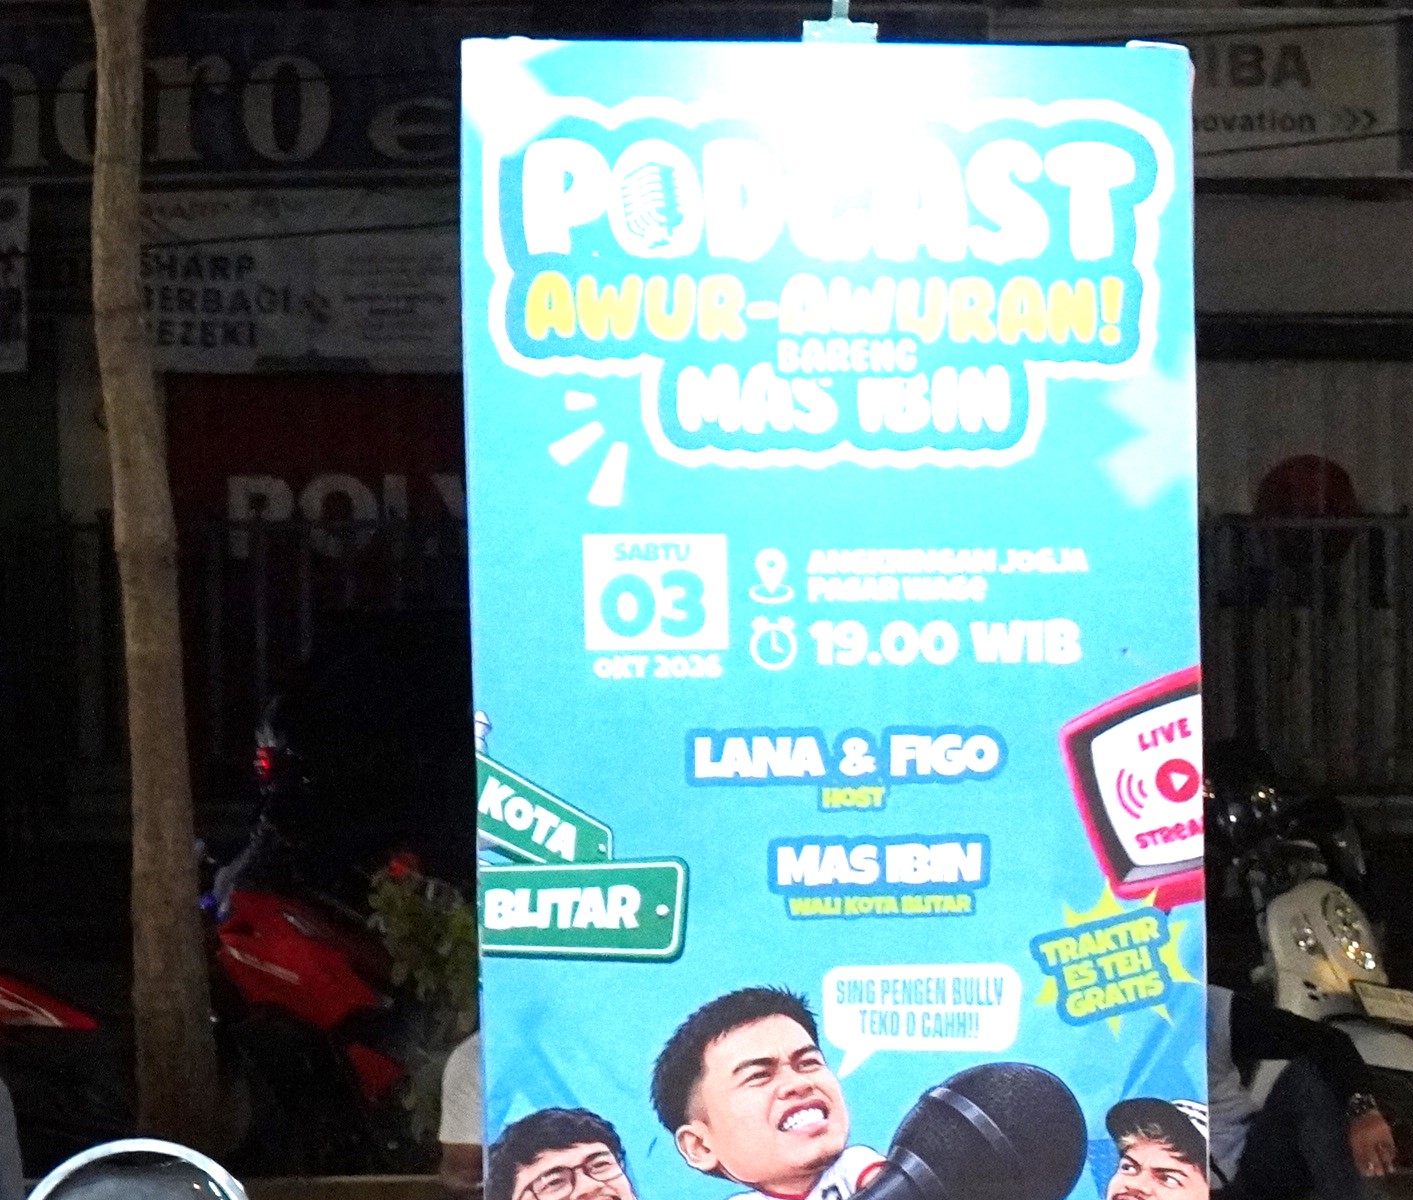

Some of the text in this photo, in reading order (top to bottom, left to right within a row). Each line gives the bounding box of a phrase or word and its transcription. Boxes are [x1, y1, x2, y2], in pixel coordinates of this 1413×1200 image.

[1193, 109, 1316, 133] ovation
[521, 137, 1137, 263] PODCAST
[524, 270, 1125, 346] AWUR-AWURAN!
[143, 319, 258, 347] EZEKI
[777, 337, 919, 373] BARENG
[675, 364, 1012, 434] MAS IBIN
[614, 542, 691, 562] SABTU
[600, 569, 706, 638] 03
[808, 618, 1082, 666] 19.00 WIB
[593, 654, 650, 680] OKT
[1138, 716, 1192, 752] LIVE
[694, 734, 1000, 779] LANA & FIGO
[477, 775, 577, 862] KOTA
[820, 785, 886, 809] HOST
[1135, 815, 1204, 849] STREA
[776, 842, 983, 886] MAS IBIN
[484, 884, 642, 931] BLITAR
[789, 893, 972, 916] WALI KOTA BLITAR
[1039, 915, 1161, 967] TRAKTIR
[1062, 945, 1153, 991] ES TEH
[836, 976, 1004, 1006] SING PENGEN BULLY
[1065, 970, 1165, 1018] GRATIS
[859, 1009, 901, 1037] TEKO
